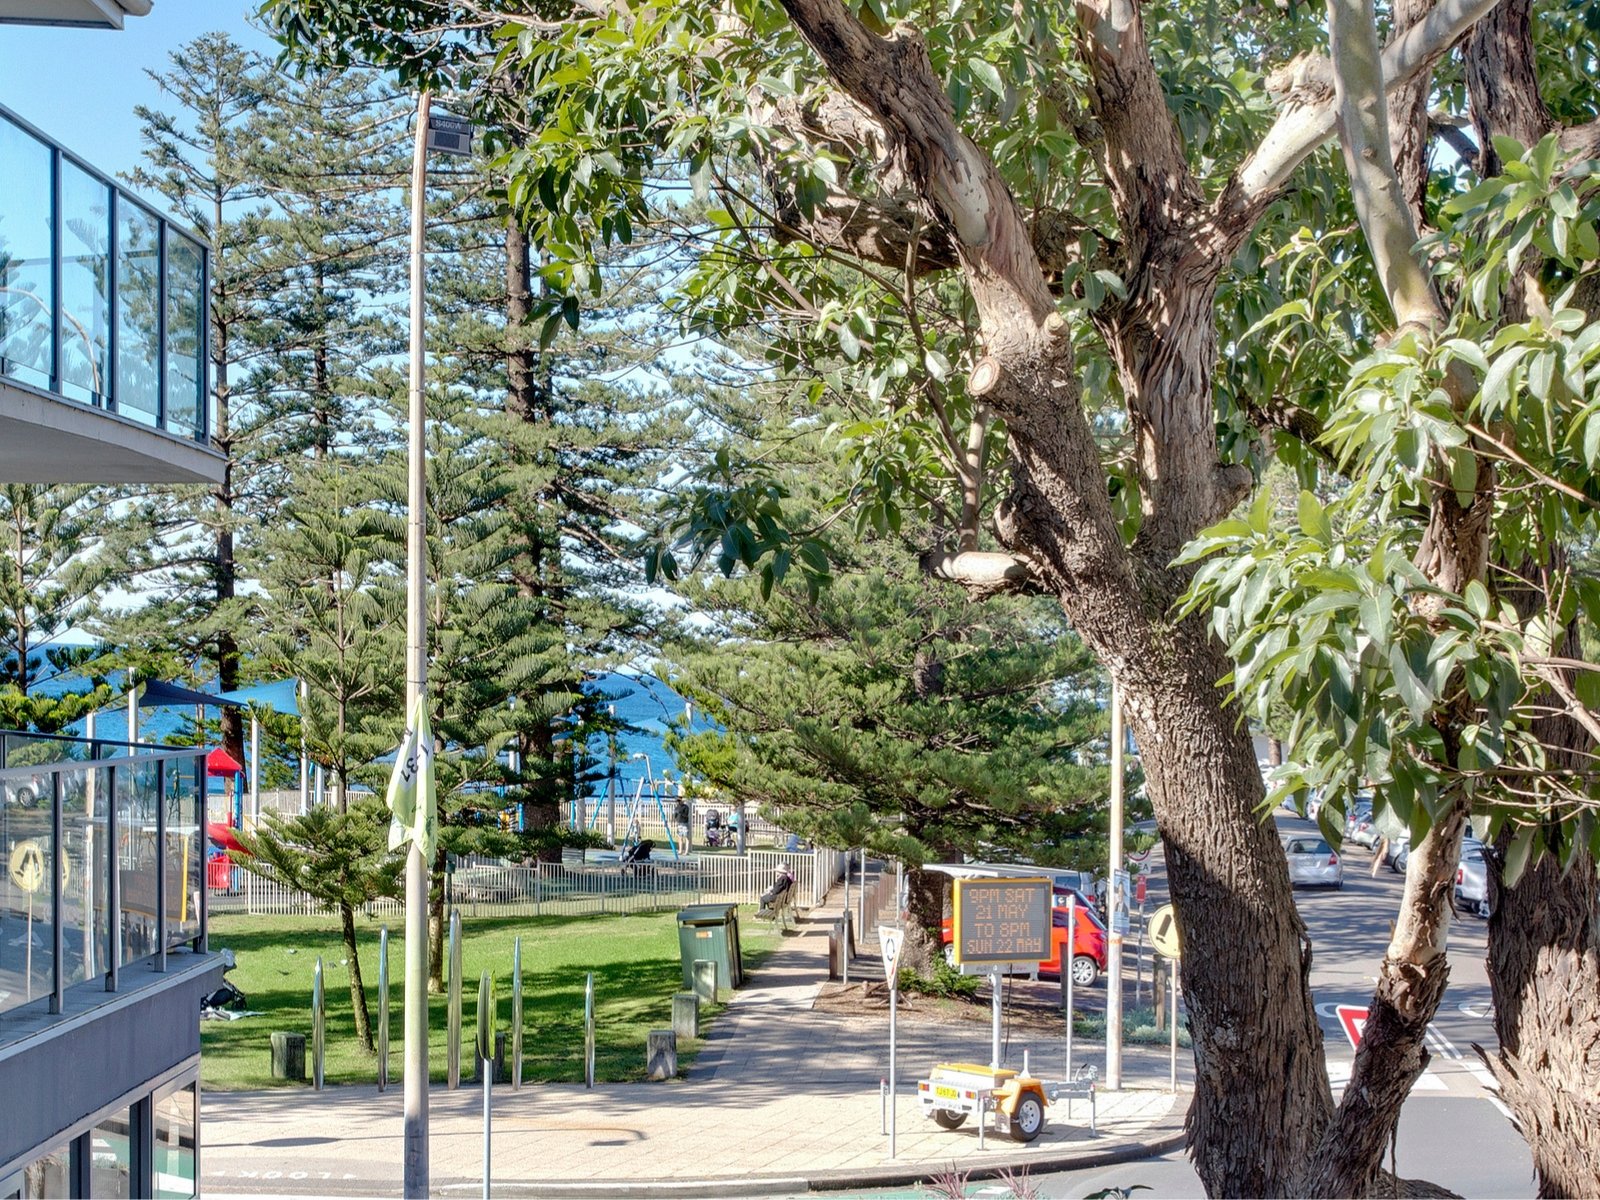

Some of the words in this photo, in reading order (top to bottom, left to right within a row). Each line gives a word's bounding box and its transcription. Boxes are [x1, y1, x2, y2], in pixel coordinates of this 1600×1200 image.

[969, 888, 1000, 903] 9PM
[1004, 888, 1035, 903] SAT
[975, 905, 992, 920] 21
[997, 904, 1028, 919] MAY
[974, 923, 994, 938] TO
[999, 922, 1031, 937] 8PM
[967, 939, 993, 954] SUN
[996, 939, 1013, 954] 22
[1016, 938, 1042, 953] MAY
